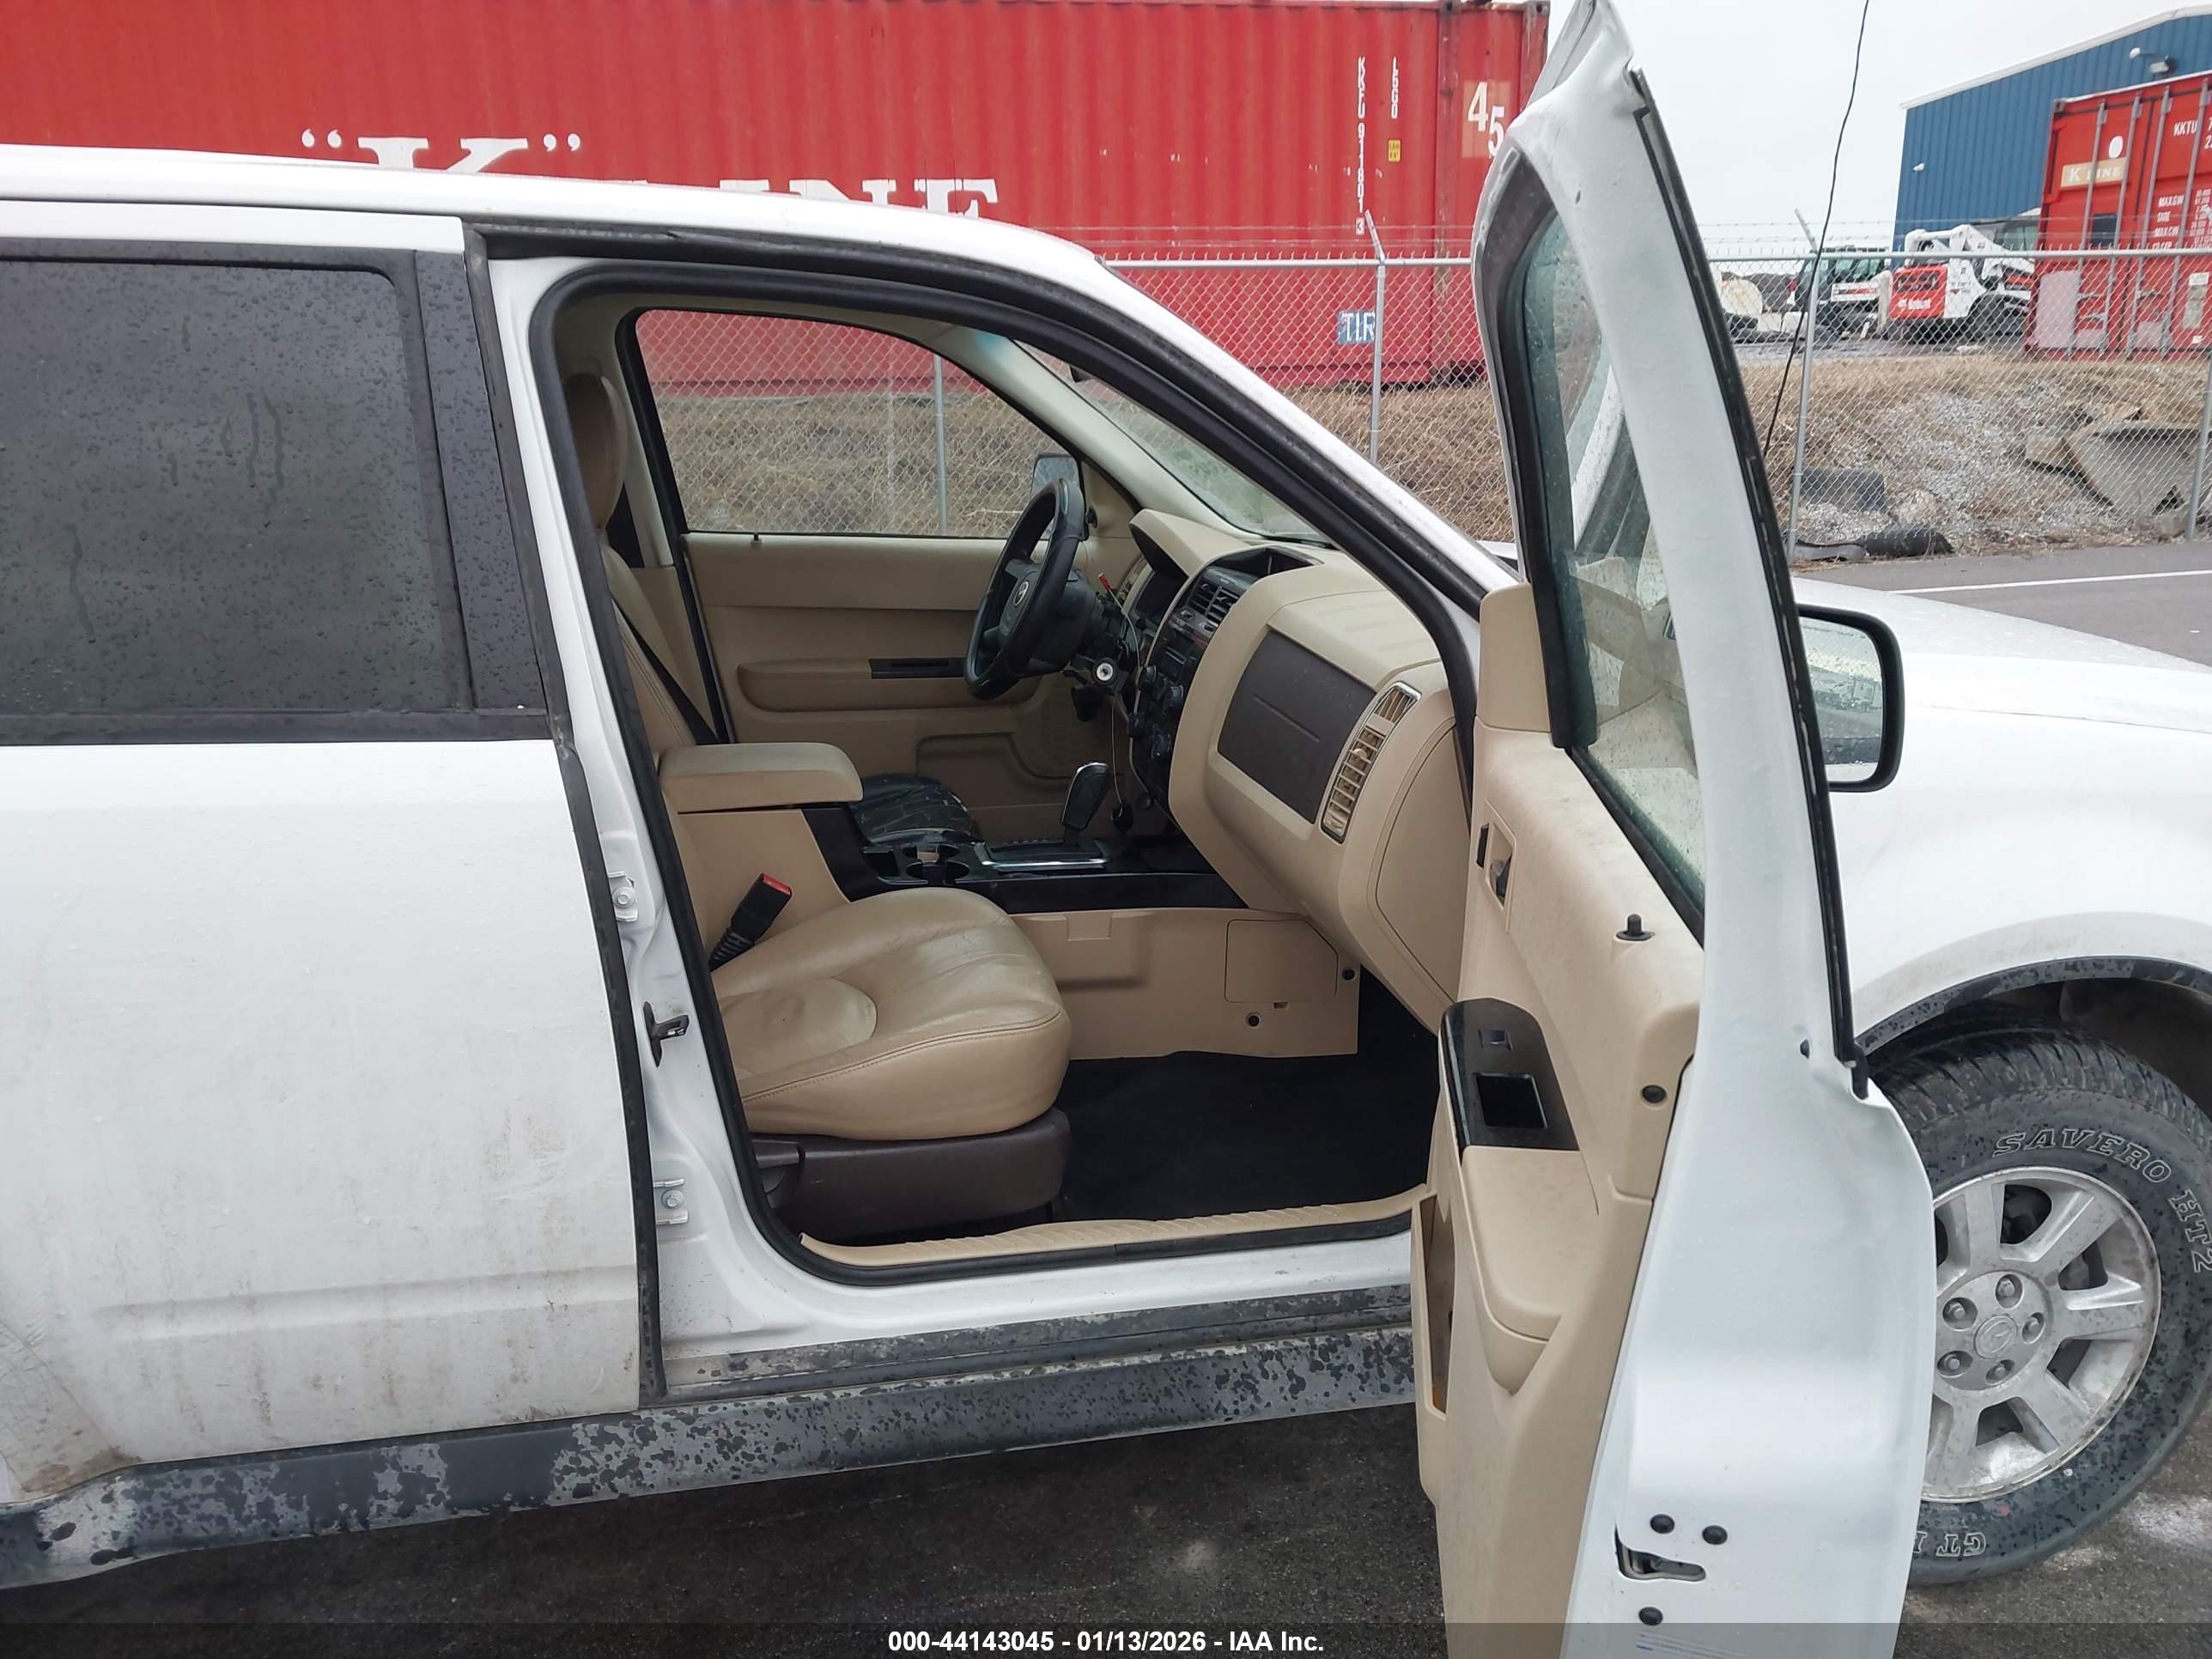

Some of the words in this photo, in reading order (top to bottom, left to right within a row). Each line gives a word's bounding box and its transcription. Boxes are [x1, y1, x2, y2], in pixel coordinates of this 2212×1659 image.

[1358, 56, 1366, 118] KKFU
[1468, 81, 1505, 158] 45
[1357, 123, 1365, 213] 911801
[1356, 217, 1365, 235] 3
[1342, 311, 1376, 342] TIR
[1991, 1128, 2172, 1183] SAVERO
[2168, 1188, 2212, 1273] HT2
[1936, 1531, 1987, 1557] GT
